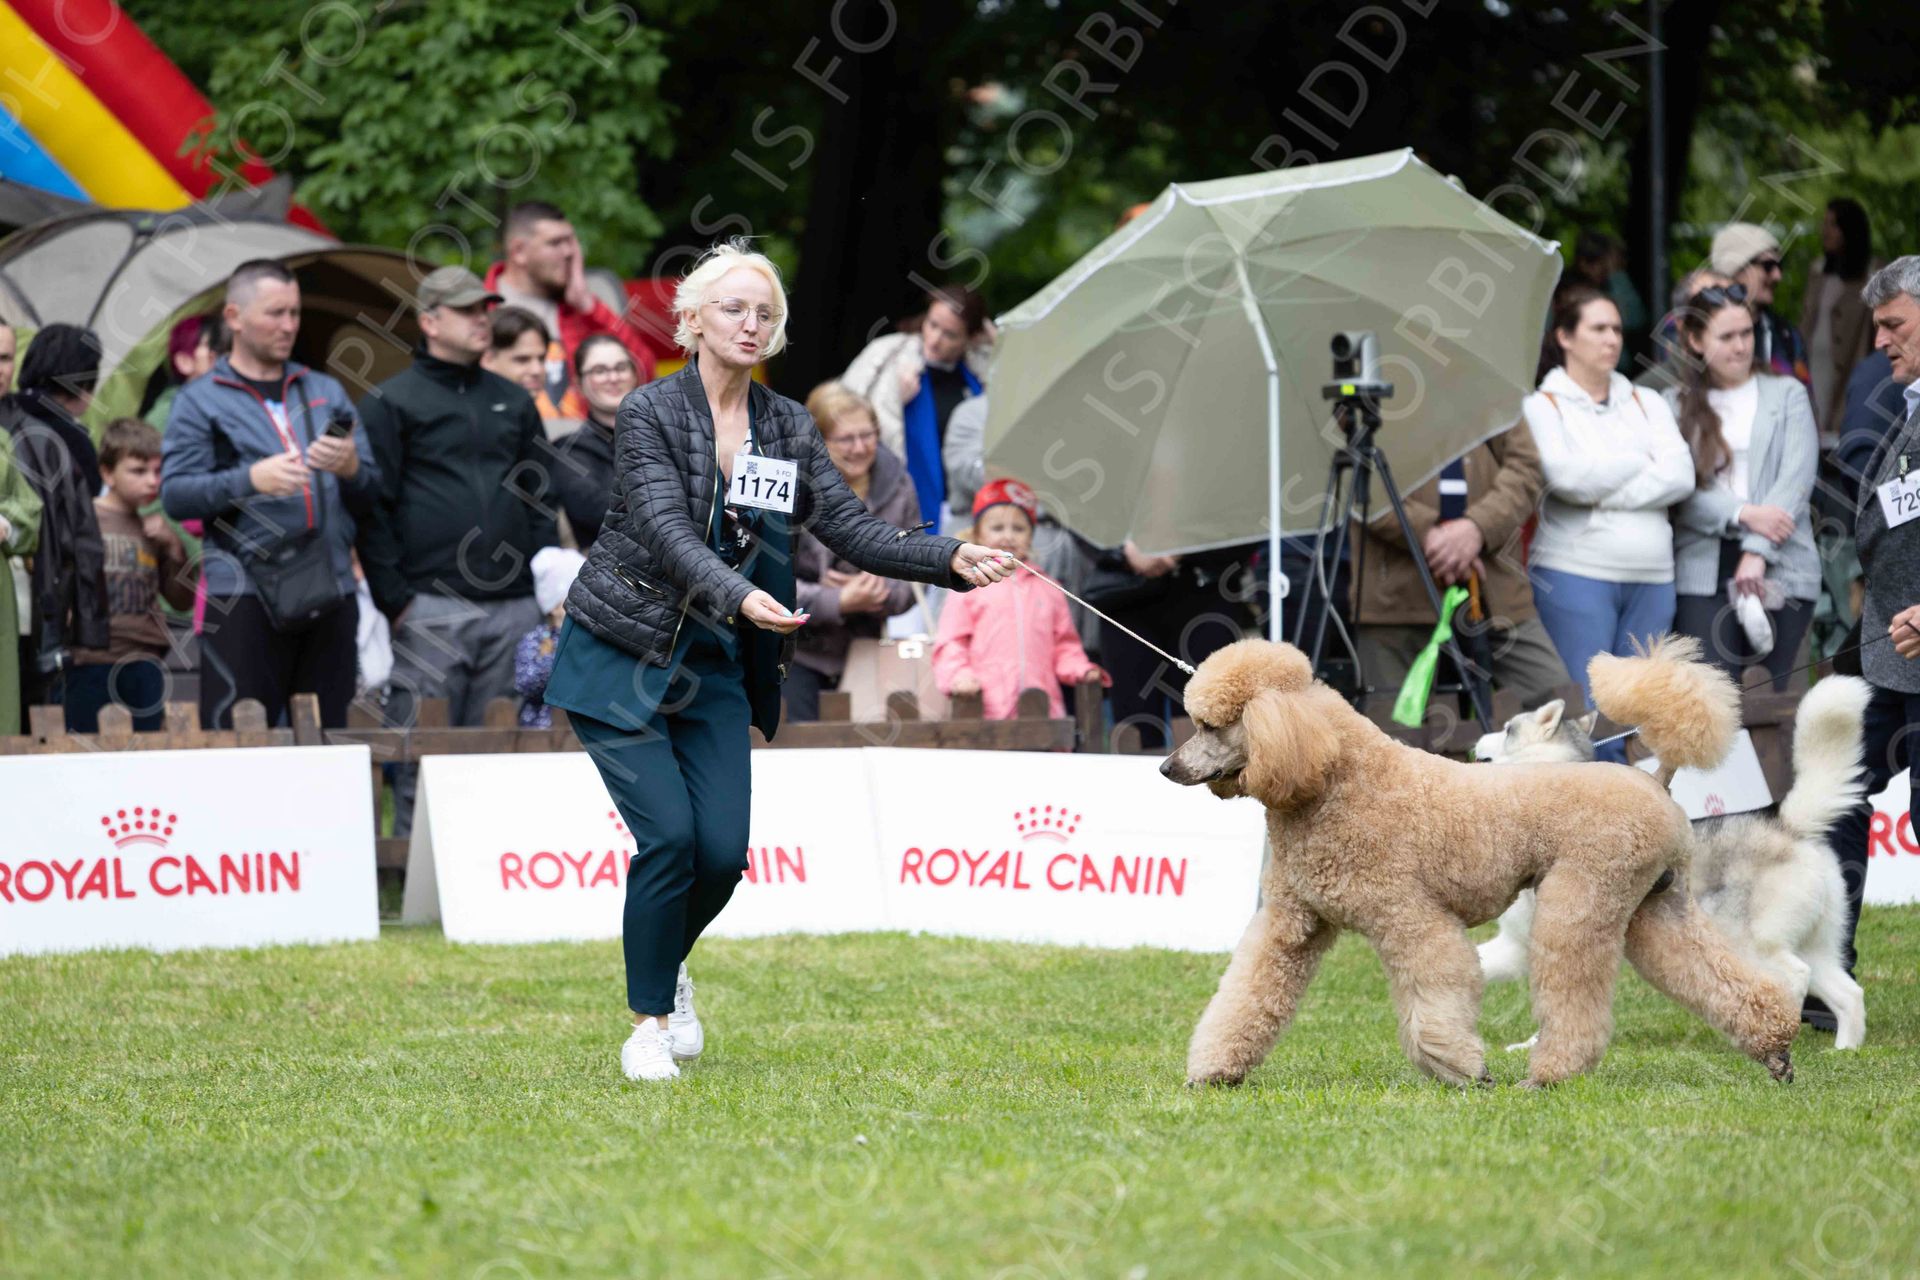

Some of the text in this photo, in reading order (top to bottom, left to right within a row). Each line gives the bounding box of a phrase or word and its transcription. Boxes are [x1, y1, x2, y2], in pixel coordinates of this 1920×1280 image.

[737, 474, 790, 503] 1174
[148, 851, 300, 897] CANIN
[900, 847, 1187, 897] ROYAL CANIN
